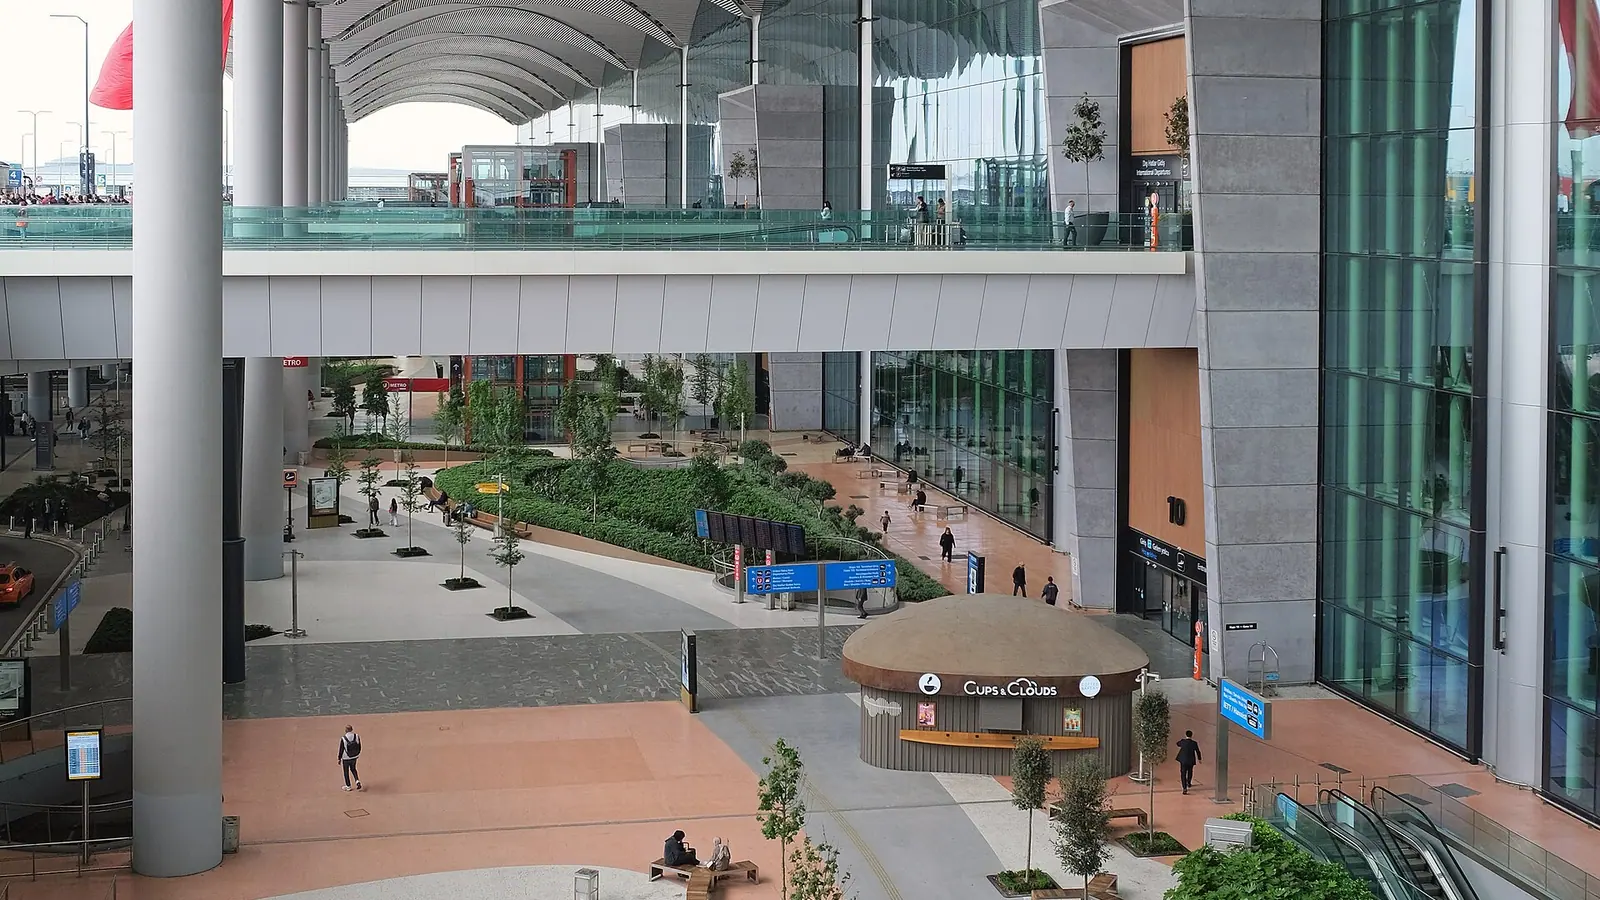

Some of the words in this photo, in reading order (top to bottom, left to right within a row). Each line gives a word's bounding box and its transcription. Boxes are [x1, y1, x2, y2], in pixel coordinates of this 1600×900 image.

[10, 171, 17, 179] 4
[1167, 495, 1186, 526] 10
[964, 681, 998, 695] CUPS
[1000, 687, 1007, 696] &
[1007, 678, 1057, 695] CLOUDS
